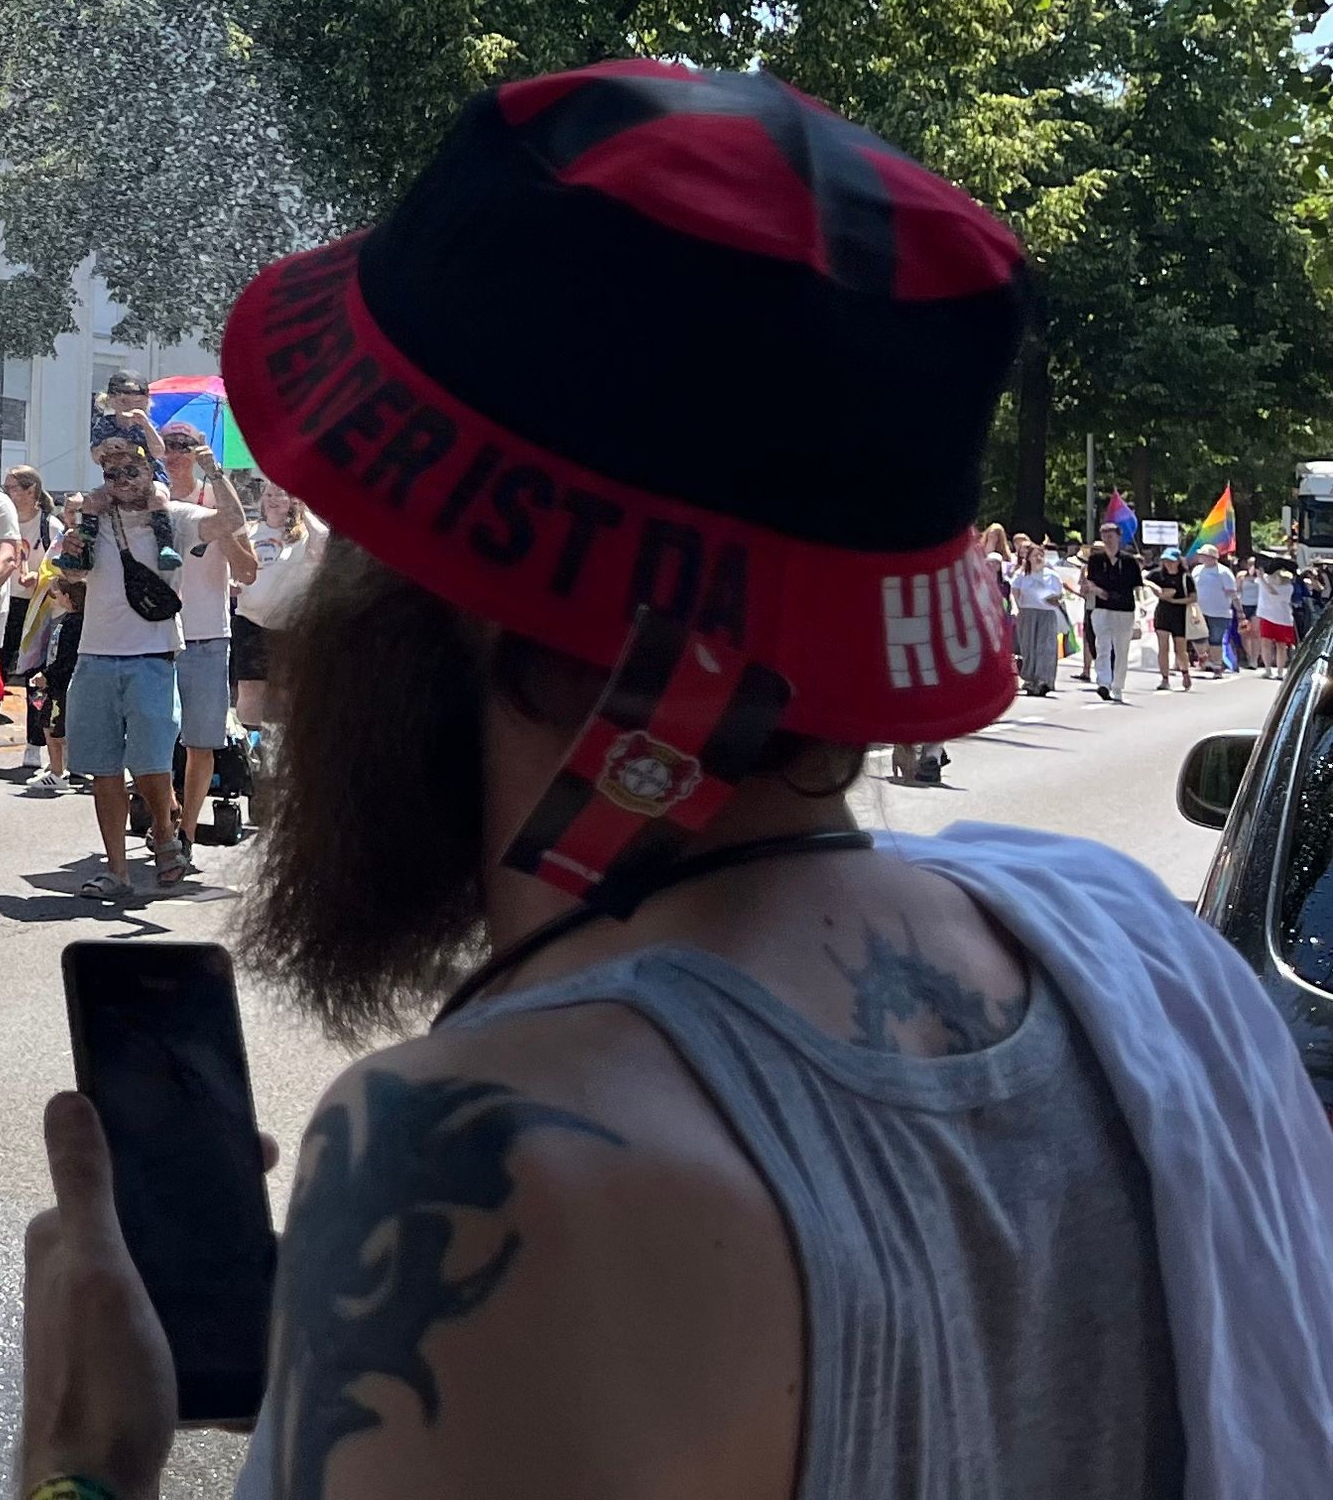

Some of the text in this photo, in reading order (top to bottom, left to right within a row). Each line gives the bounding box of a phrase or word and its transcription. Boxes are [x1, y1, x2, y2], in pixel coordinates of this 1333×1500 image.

[299, 355, 459, 507] DER
[434, 445, 625, 597] IST
[624, 517, 749, 647] DA
